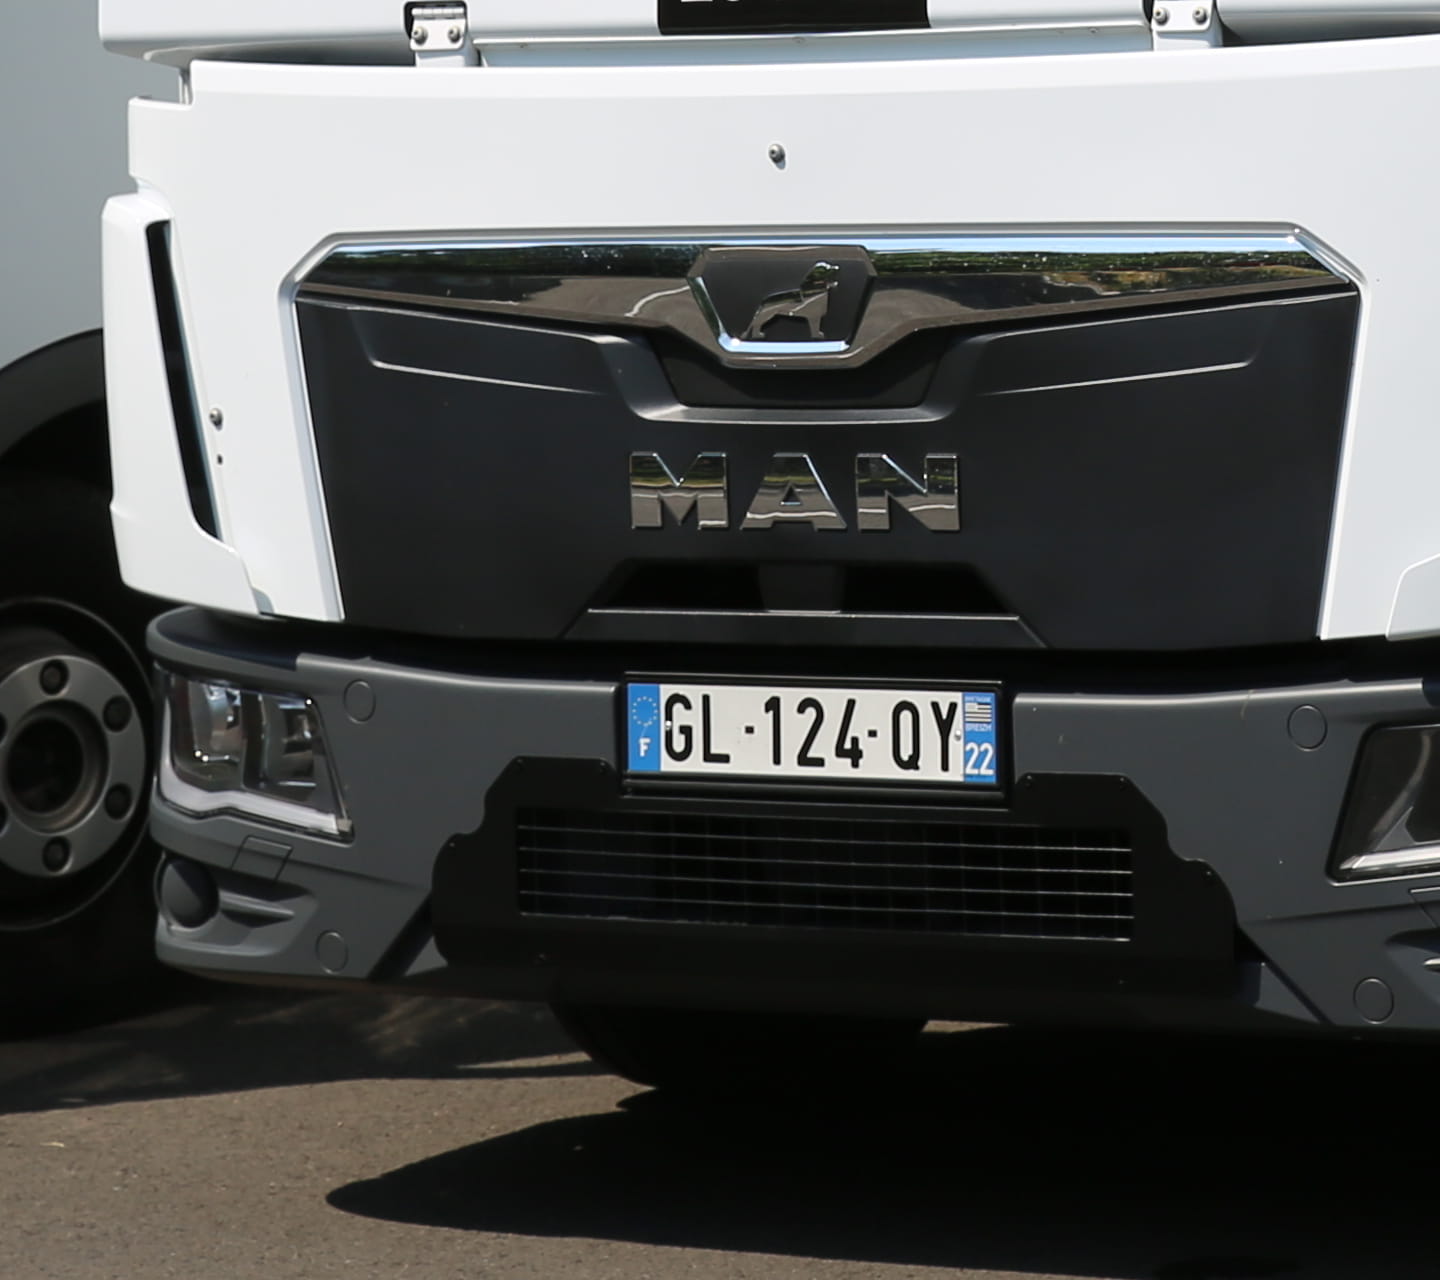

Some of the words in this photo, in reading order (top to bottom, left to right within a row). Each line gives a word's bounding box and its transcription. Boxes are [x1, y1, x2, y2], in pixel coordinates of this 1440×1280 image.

[629, 451, 960, 531] MAN
[638, 737, 652, 758] F
[964, 741, 996, 776] 22
